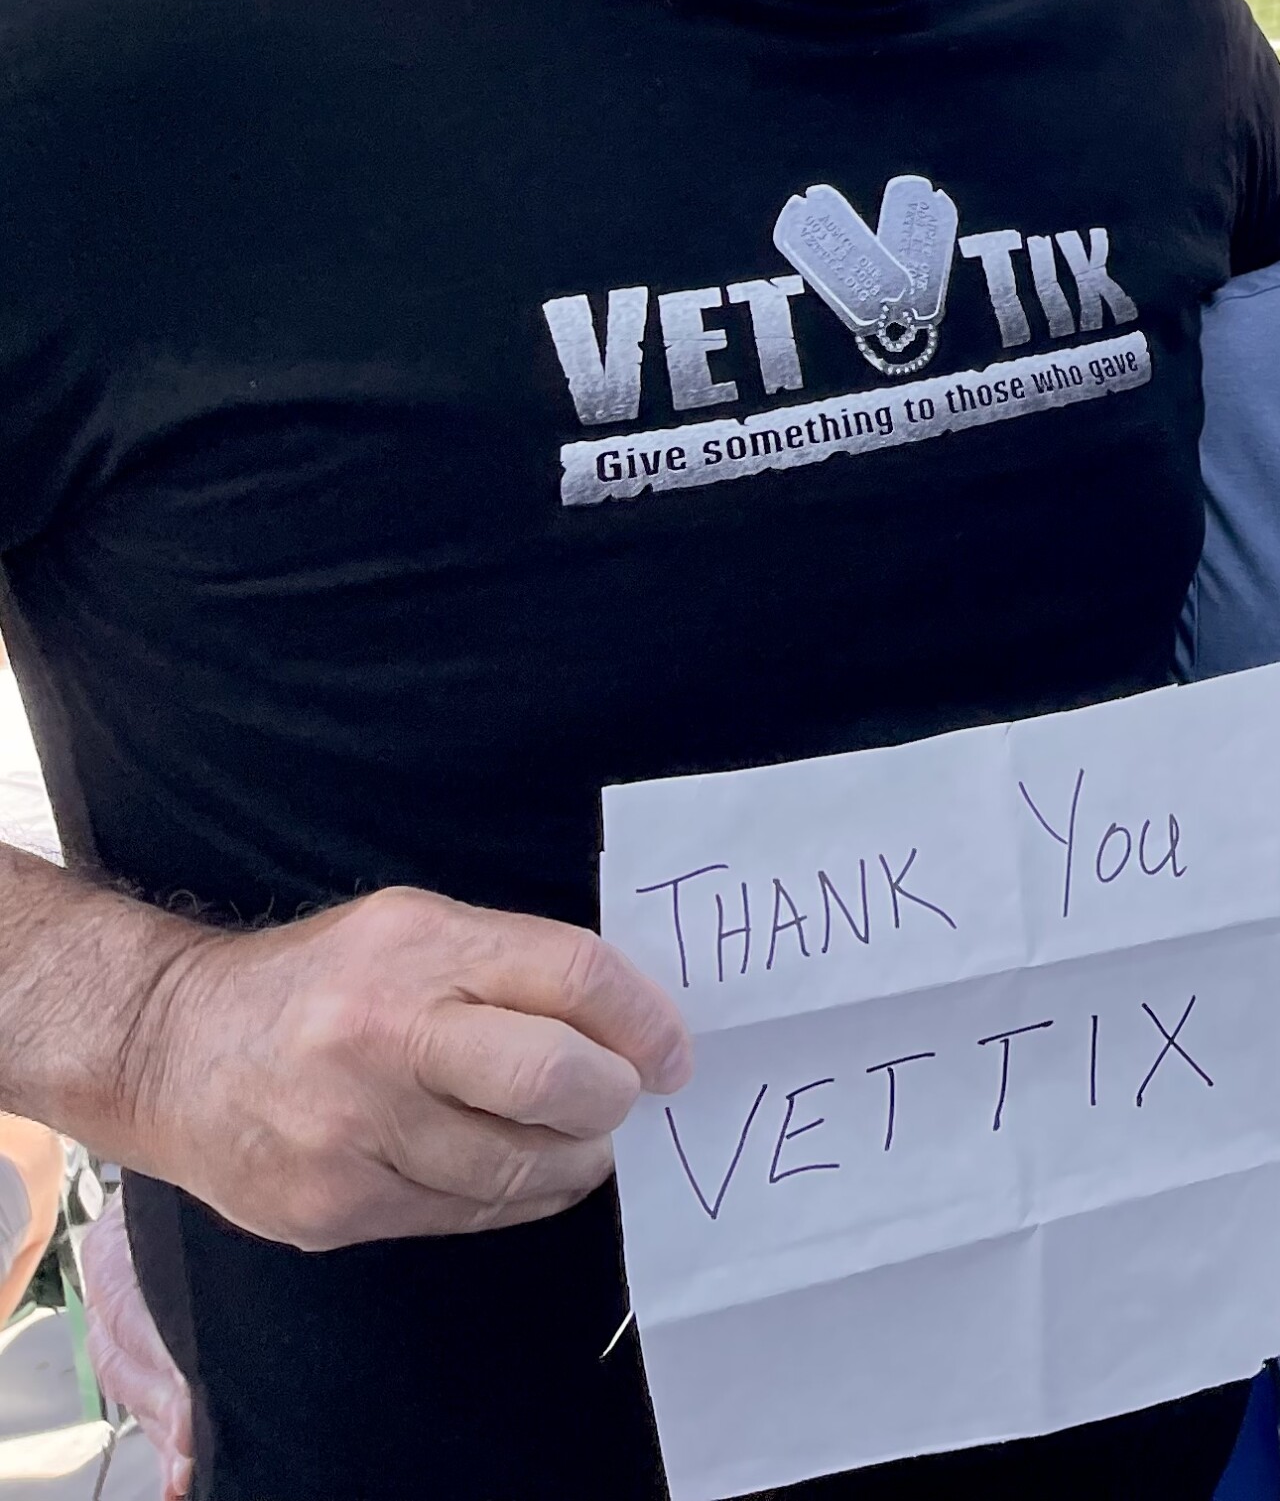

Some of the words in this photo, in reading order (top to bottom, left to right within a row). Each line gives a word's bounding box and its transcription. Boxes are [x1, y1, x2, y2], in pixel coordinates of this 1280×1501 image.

[543, 275, 805, 426] VET
[957, 227, 1140, 350] TIX
[596, 446, 688, 484] Give
[701, 405, 895, 468] something
[902, 395, 937, 425] to
[945, 372, 1027, 415] those
[1030, 363, 1085, 395] who
[1088, 348, 1140, 386] gave
[635, 845, 957, 990] THANK
